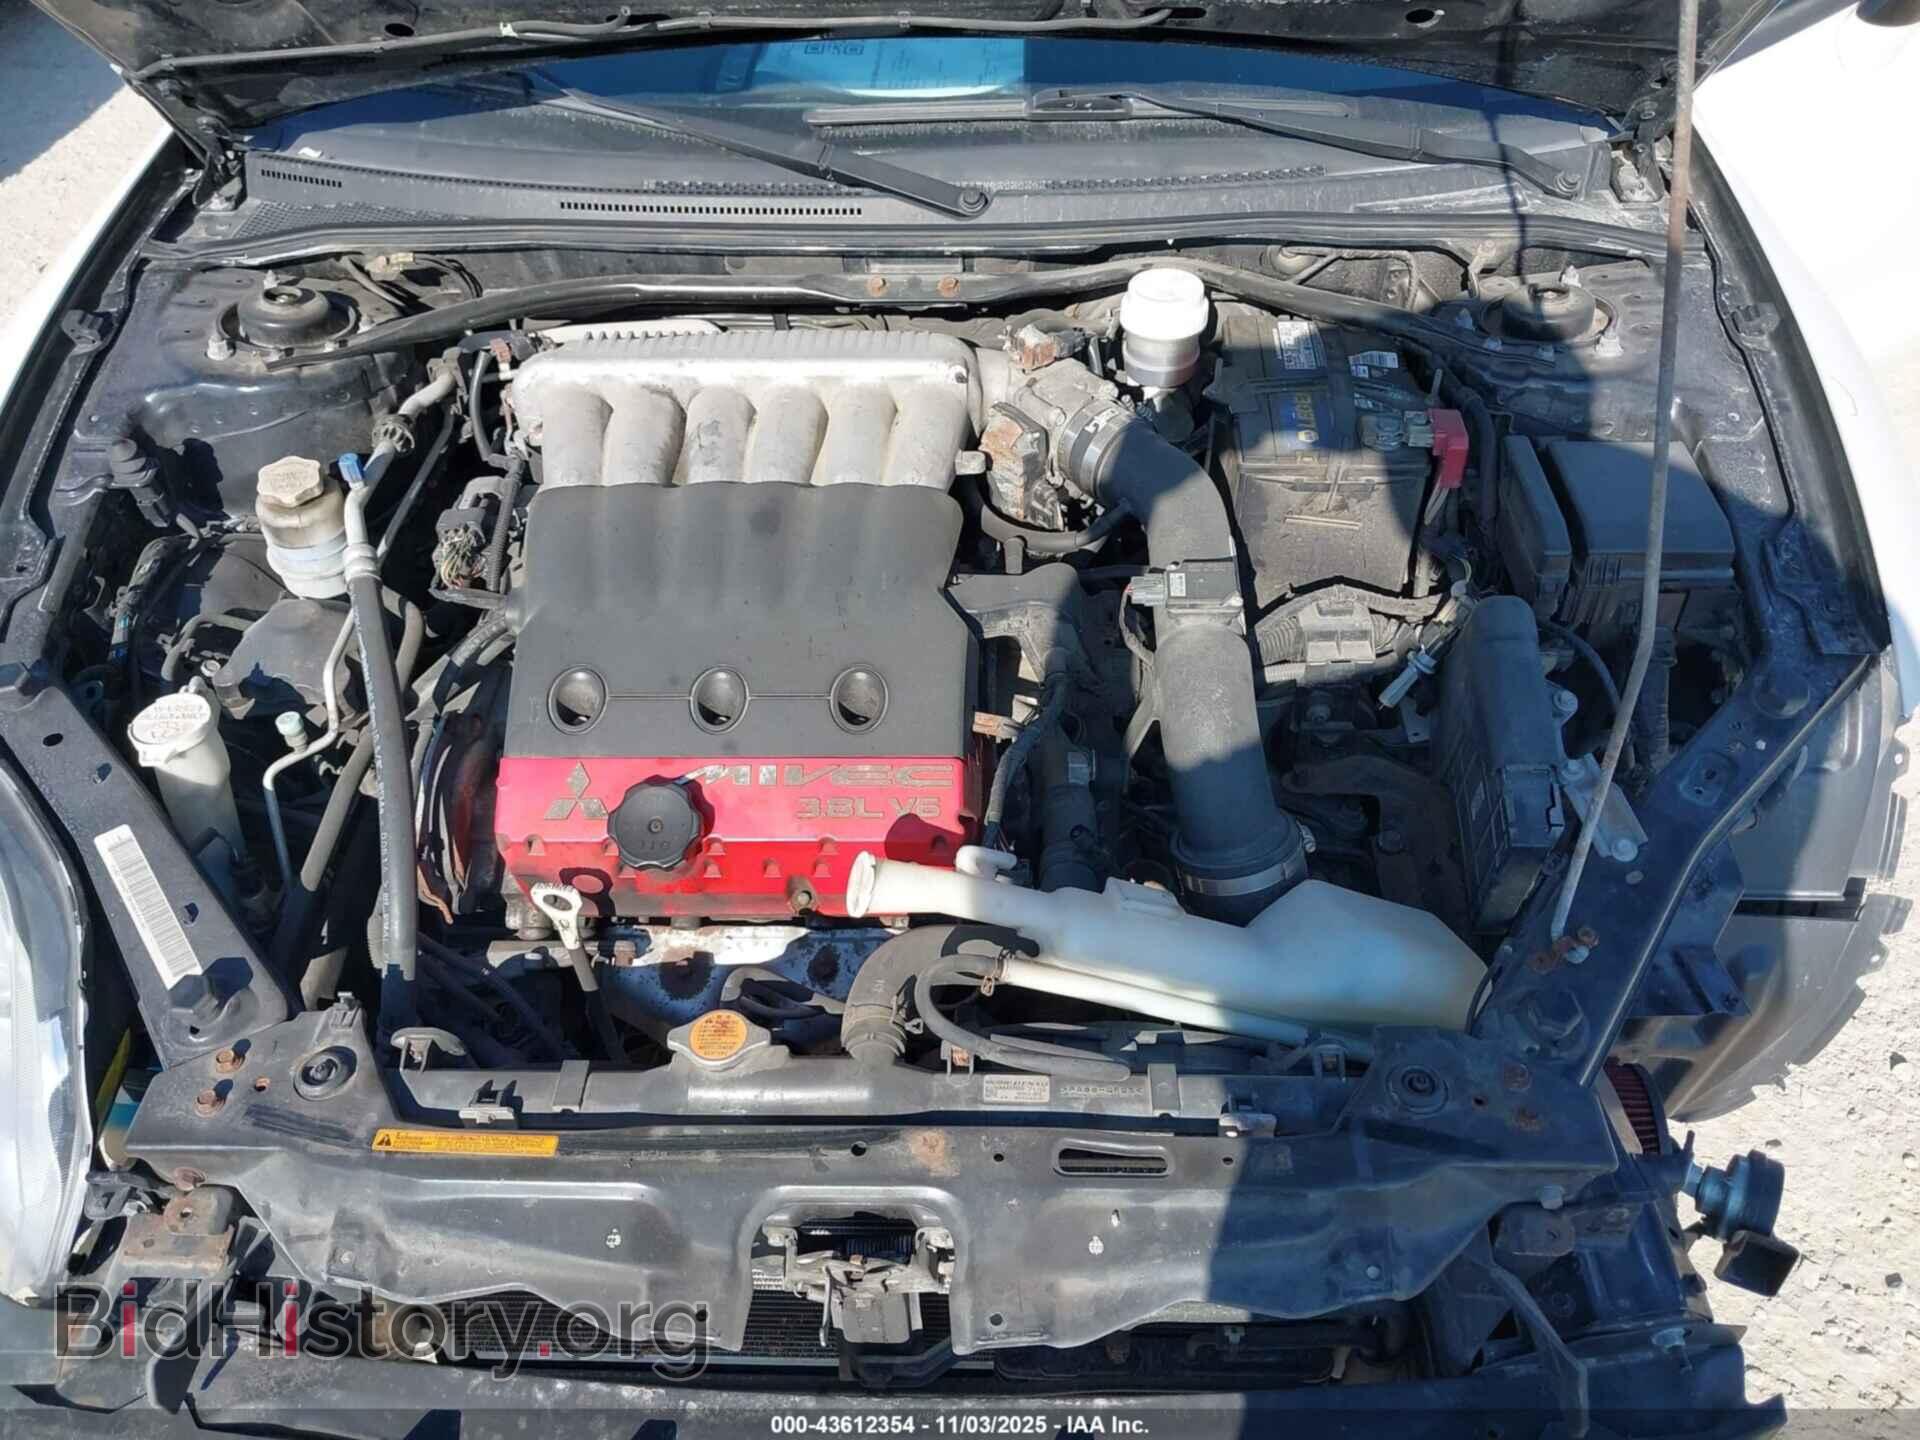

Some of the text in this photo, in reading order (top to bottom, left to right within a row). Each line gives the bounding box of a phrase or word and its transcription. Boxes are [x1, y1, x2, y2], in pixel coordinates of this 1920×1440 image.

[675, 764, 953, 786] MIVEC
[797, 796, 940, 818] 3.8L V6
